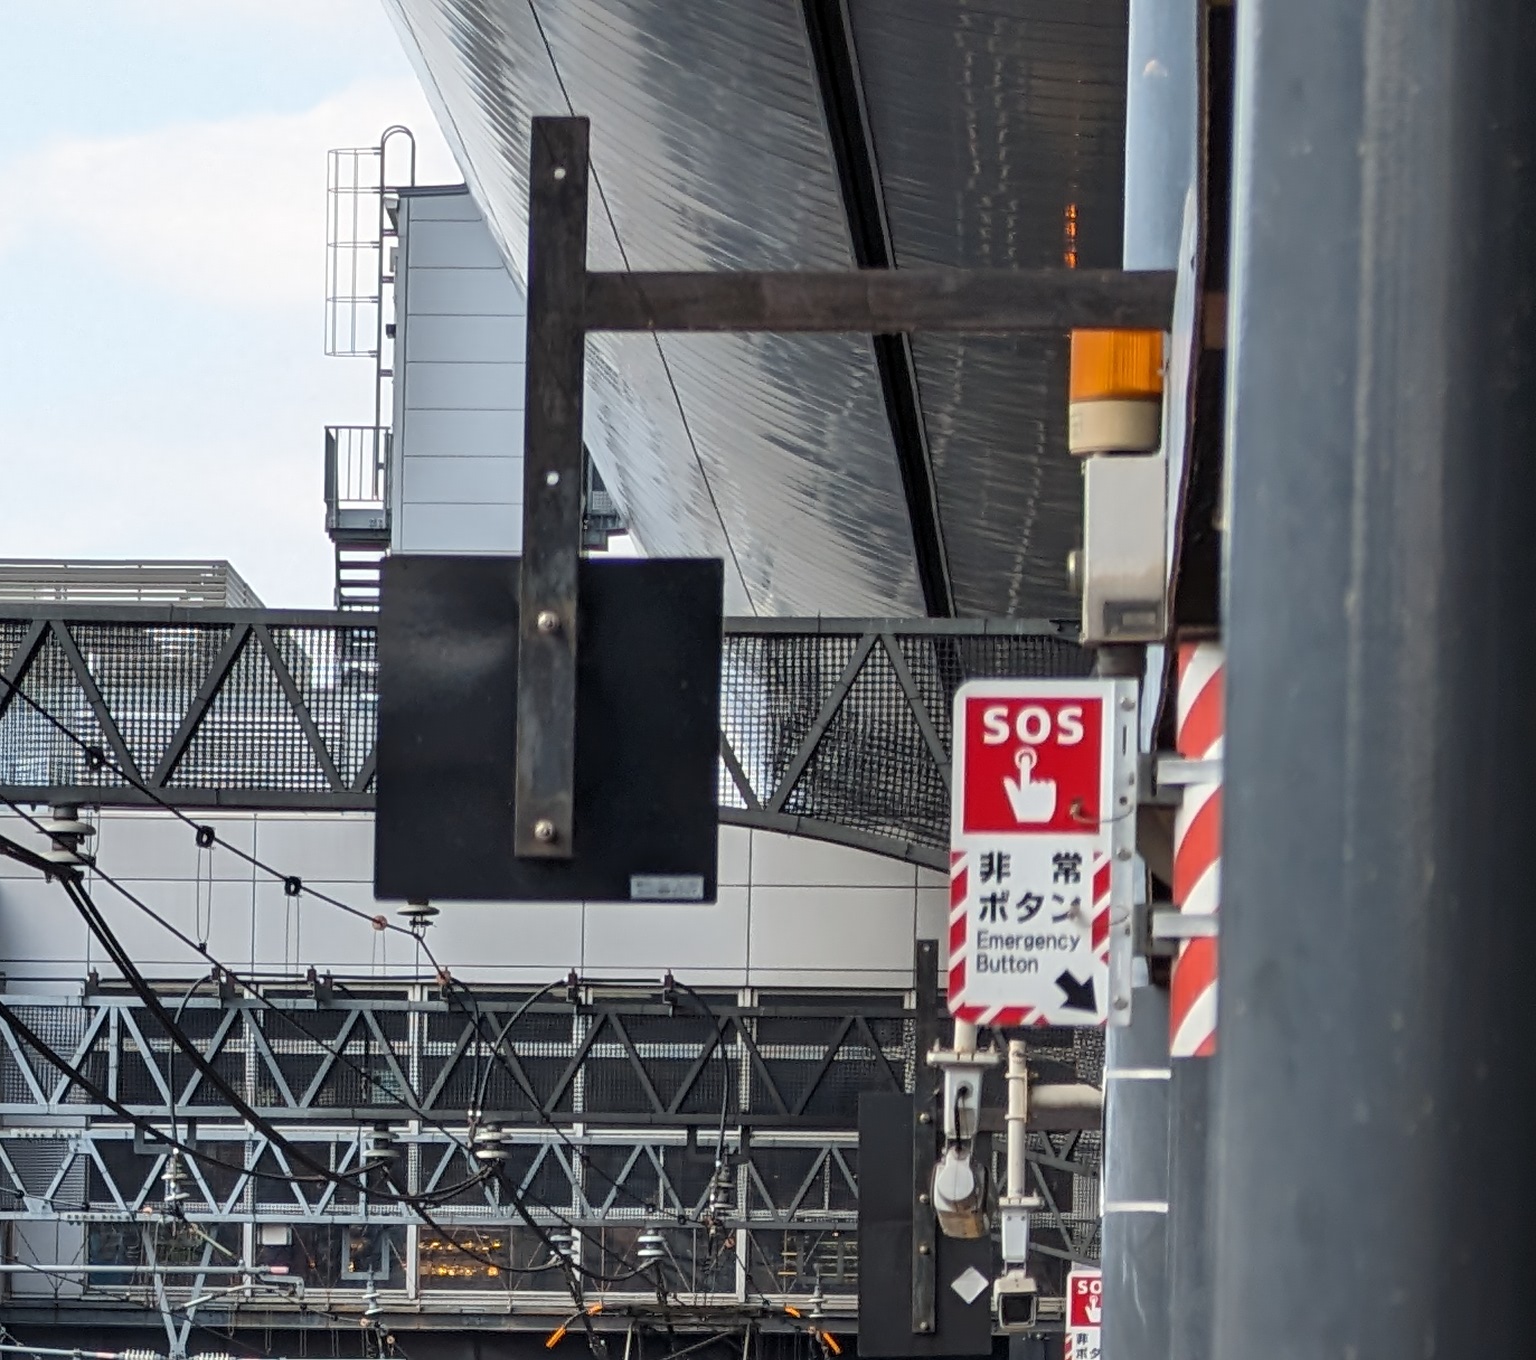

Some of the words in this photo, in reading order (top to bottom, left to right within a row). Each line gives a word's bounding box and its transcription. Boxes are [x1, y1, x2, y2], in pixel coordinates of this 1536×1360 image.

[982, 705, 1085, 746] SOS
[978, 851, 1083, 885] 非常
[978, 891, 1082, 924] ボタン
[976, 930, 1081, 952] Emergency
[976, 953, 1039, 974] Button
